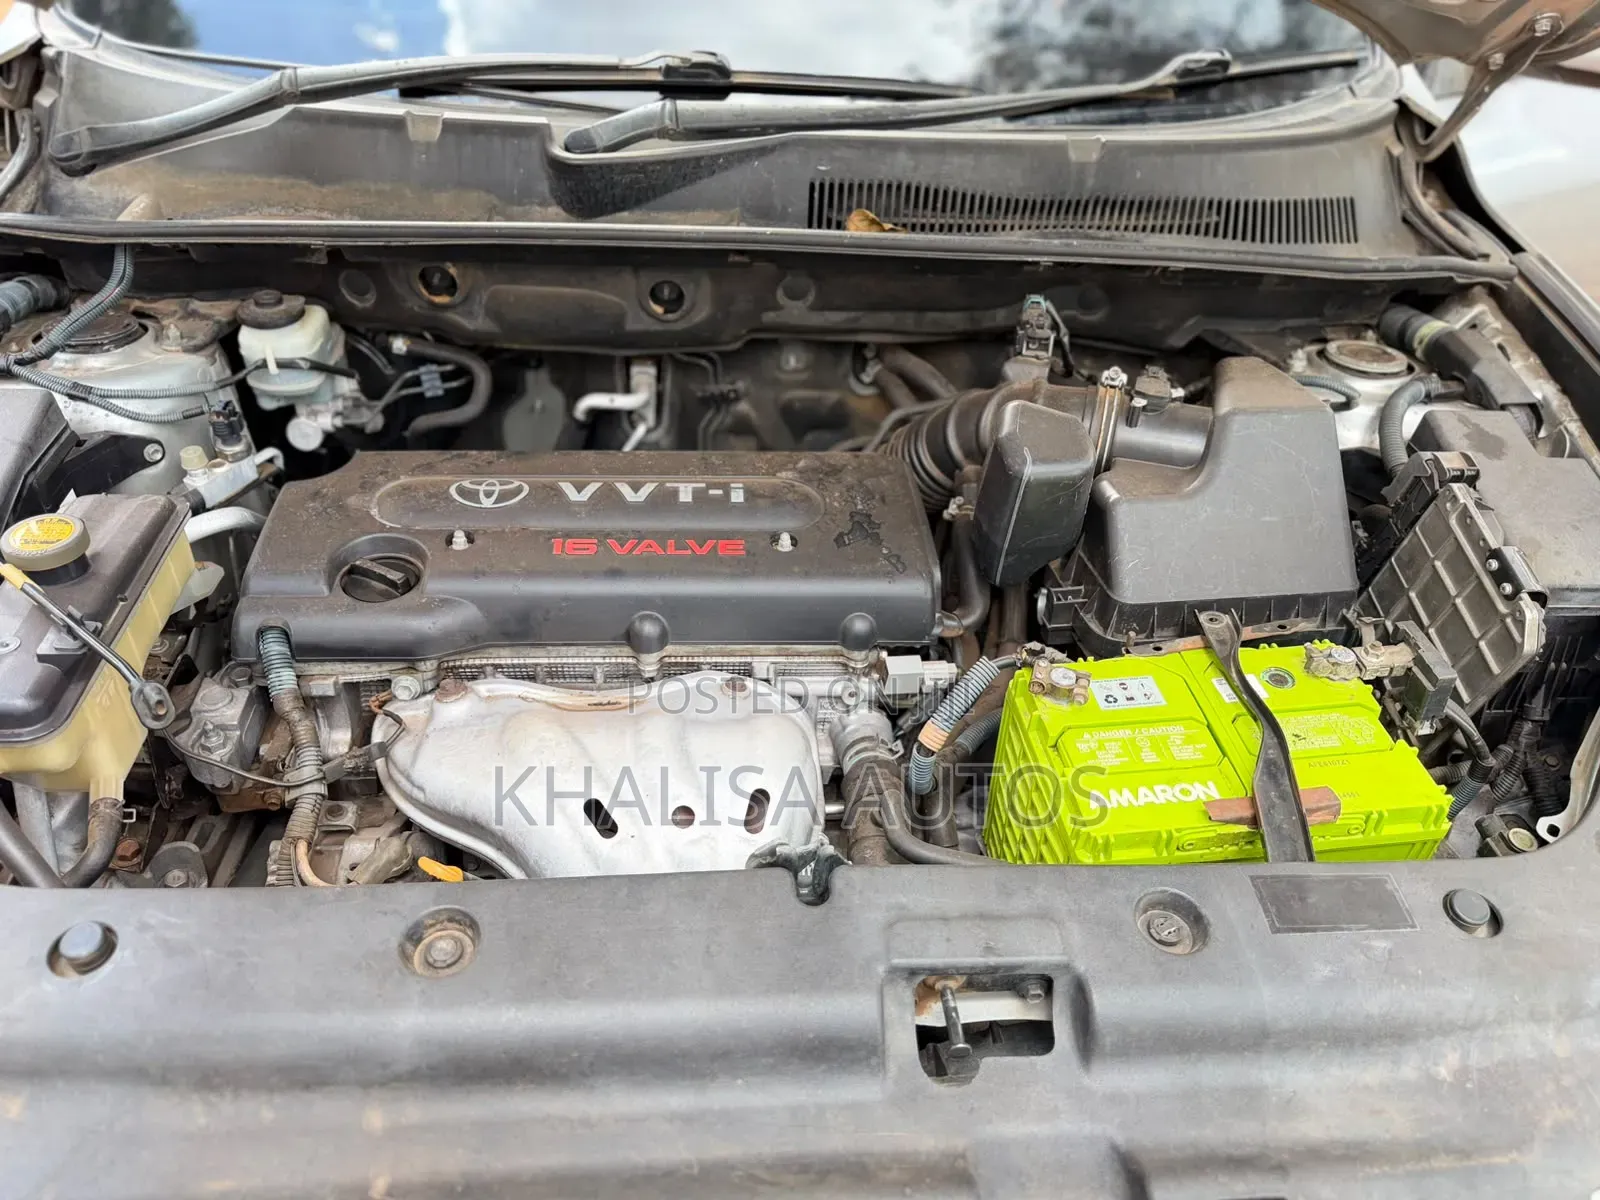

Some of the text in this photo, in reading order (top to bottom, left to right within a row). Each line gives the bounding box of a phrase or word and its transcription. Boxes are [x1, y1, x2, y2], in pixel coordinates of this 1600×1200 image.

[558, 482, 744, 502] VVT-i
[551, 538, 745, 555] 16 VALVE
[1092, 728, 1133, 739] DANGER
[1141, 725, 1185, 735] CAUTION
[1090, 780, 1220, 810] AMARON
